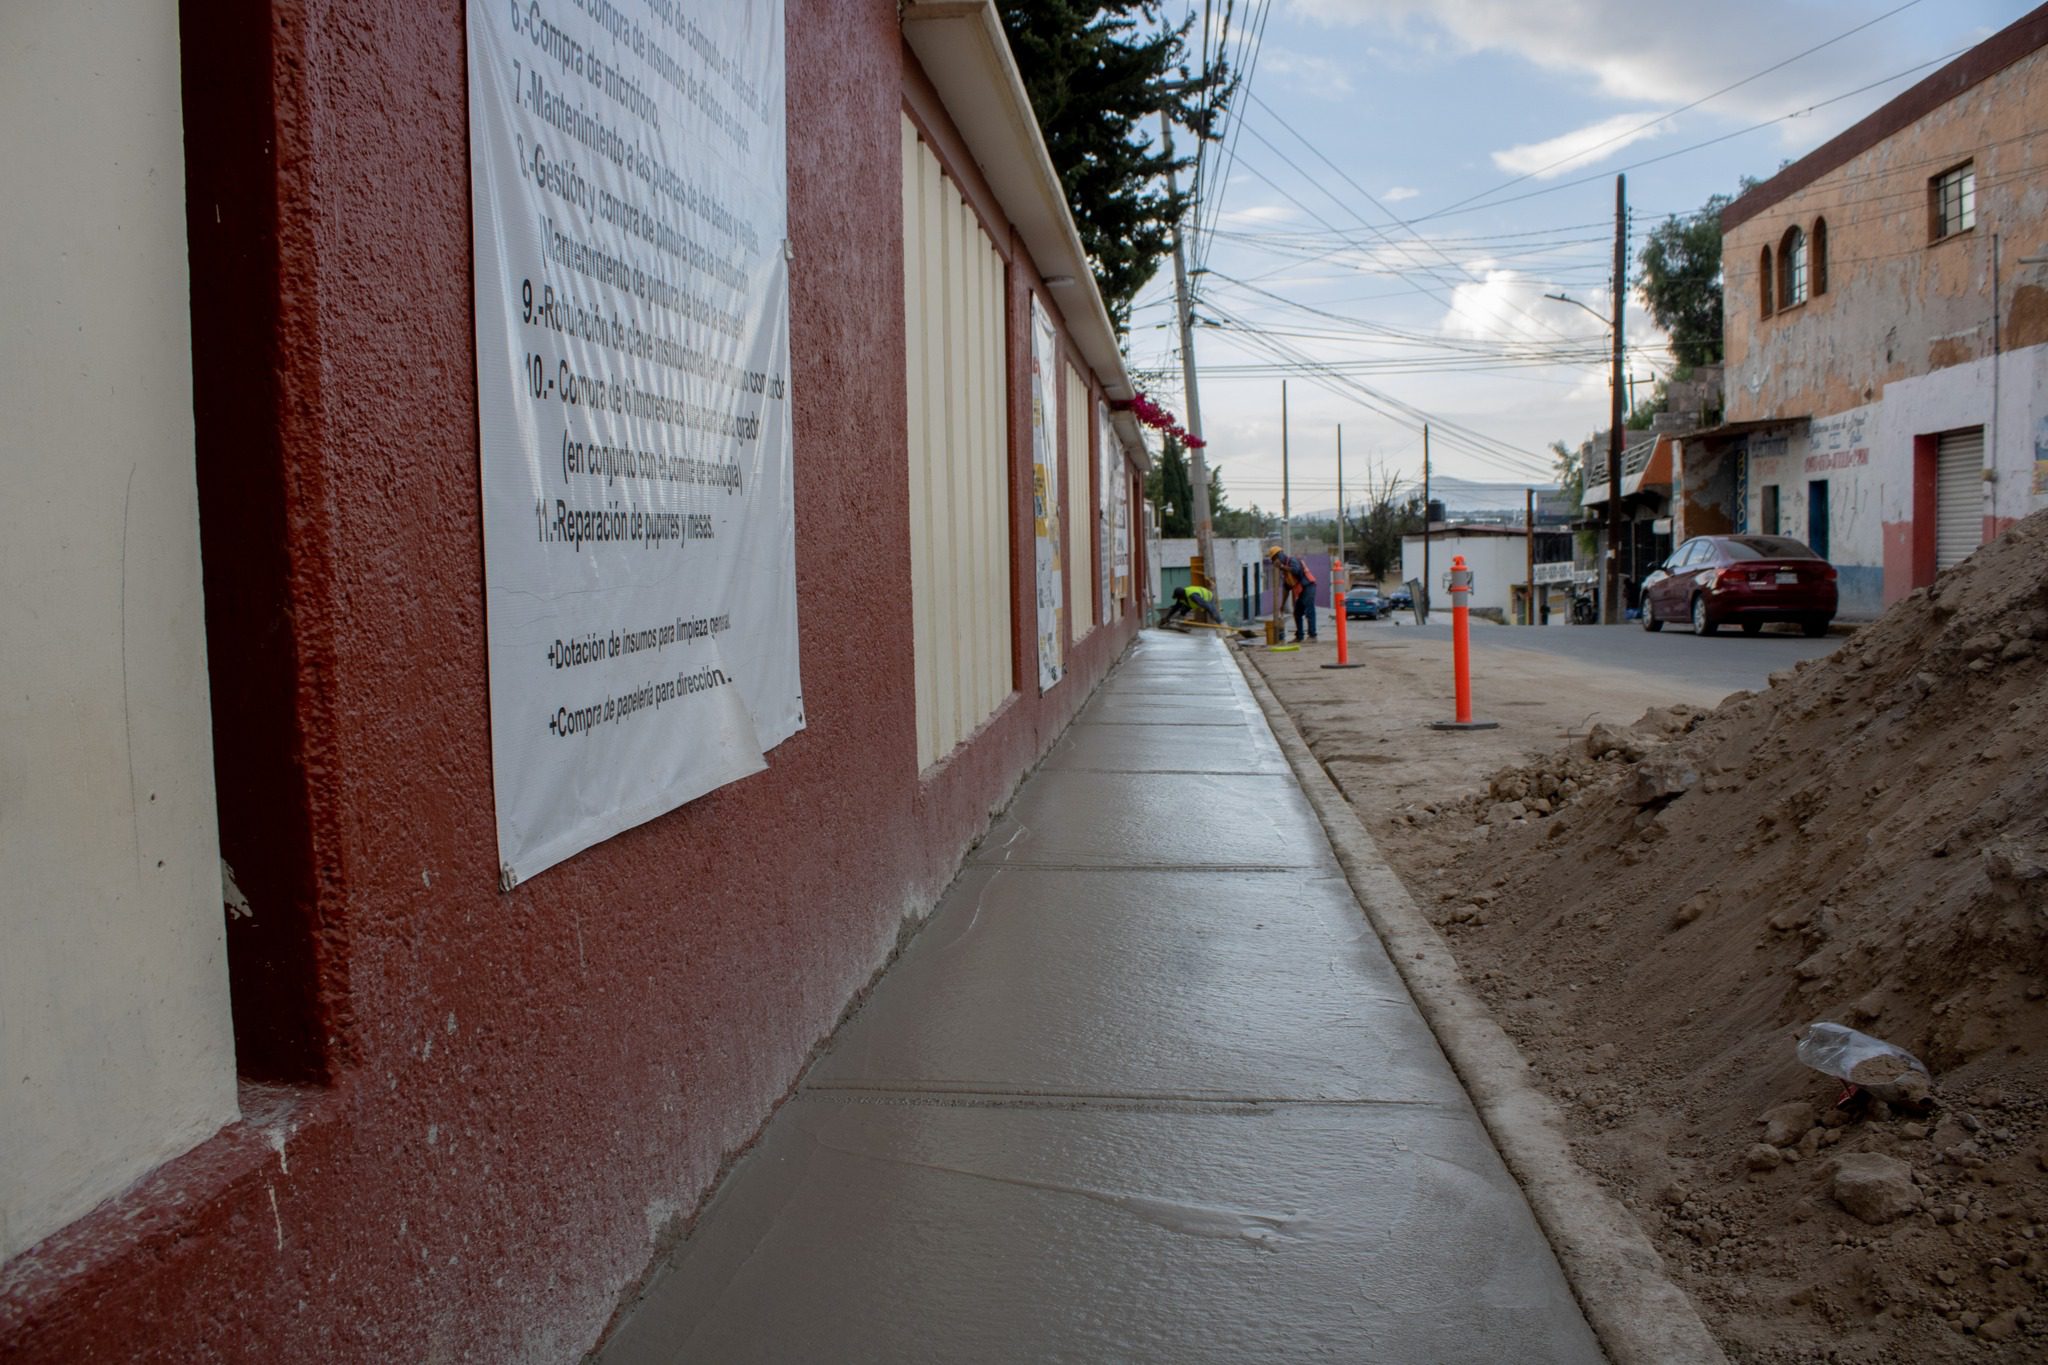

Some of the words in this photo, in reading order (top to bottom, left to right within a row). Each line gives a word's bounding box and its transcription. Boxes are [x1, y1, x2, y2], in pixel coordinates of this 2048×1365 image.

[511, 0, 583, 77] 6.-Compra
[587, 44, 602, 89] de
[675, 1, 685, 40] de
[587, 0, 629, 48] compra
[632, 18, 646, 59] de
[647, 29, 685, 95] insumos
[687, 68, 697, 106] de
[699, 79, 722, 128] dichos
[512, 58, 625, 168] 7.-Mantenimiento
[627, 143, 634, 173] a
[636, 138, 650, 184] las
[653, 159, 686, 207] puertas
[687, 177, 697, 214] de
[699, 184, 710, 222] los
[733, 218, 739, 248] y
[517, 133, 585, 209] 8.-Gestión
[588, 182, 596, 224] y
[599, 189, 639, 240] compra
[642, 204, 654, 244] de
[656, 214, 688, 263] pintura
[689, 238, 705, 273] para
[706, 242, 713, 277] la
[538, 212, 630, 293] (Mantenimiento
[632, 259, 645, 300] de
[647, 267, 679, 315] pintura
[680, 281, 690, 320] de
[691, 287, 709, 328] toda
[710, 294, 717, 331] la
[521, 278, 608, 348] 9.-Rotulación
[611, 311, 624, 352] de
[627, 317, 652, 361] clave
[655, 328, 705, 378] institucional
[525, 351, 554, 400] 10.-
[559, 358, 605, 416] Compra
[608, 370, 621, 414] de
[624, 376, 631, 416] 6
[631, 377, 684, 428] impresoras
[562, 427, 584, 485] (en
[587, 434, 636, 488] conjunto
[638, 449, 656, 480] con
[658, 446, 667, 481] el
[696, 450, 705, 485] de
[536, 497, 628, 553] 11.-Reparación
[630, 502, 643, 541] de
[644, 508, 680, 550] pupitres
[681, 513, 687, 549] y
[687, 513, 714, 539] mesas.
[548, 633, 605, 670] +Dotación
[608, 630, 621, 658] de
[622, 628, 657, 655] insumos
[659, 624, 675, 652] para
[676, 614, 708, 645] limpieza
[549, 704, 603, 737] +Compra
[603, 694, 615, 722] de
[616, 681, 653, 725] papelería
[655, 679, 675, 710] para
[676, 665, 732, 697] dirección.
